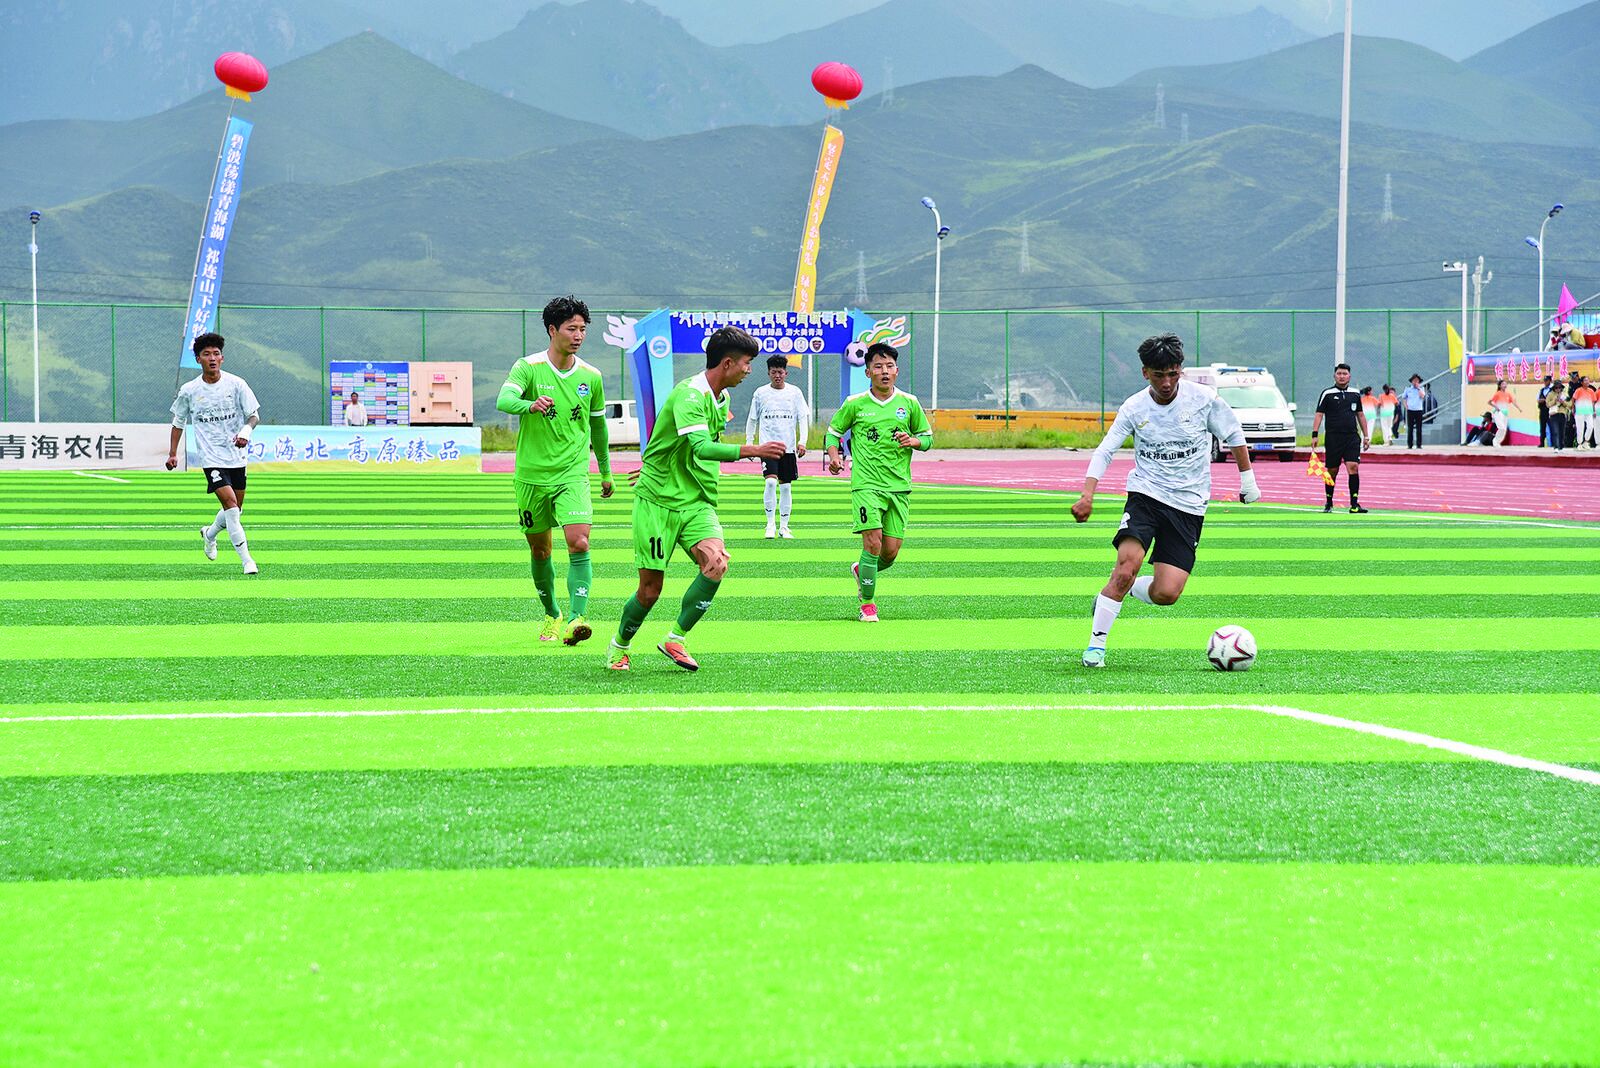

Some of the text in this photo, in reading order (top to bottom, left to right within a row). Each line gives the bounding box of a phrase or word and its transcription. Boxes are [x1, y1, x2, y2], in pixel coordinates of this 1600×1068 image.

[210, 133, 244, 242] 碧波荡漾青海湖
[0, 434, 124, 460] 青海农信
[348, 435, 459, 463] 高原臻品
[859, 506, 868, 524] 8
[649, 536, 664, 560] 10
